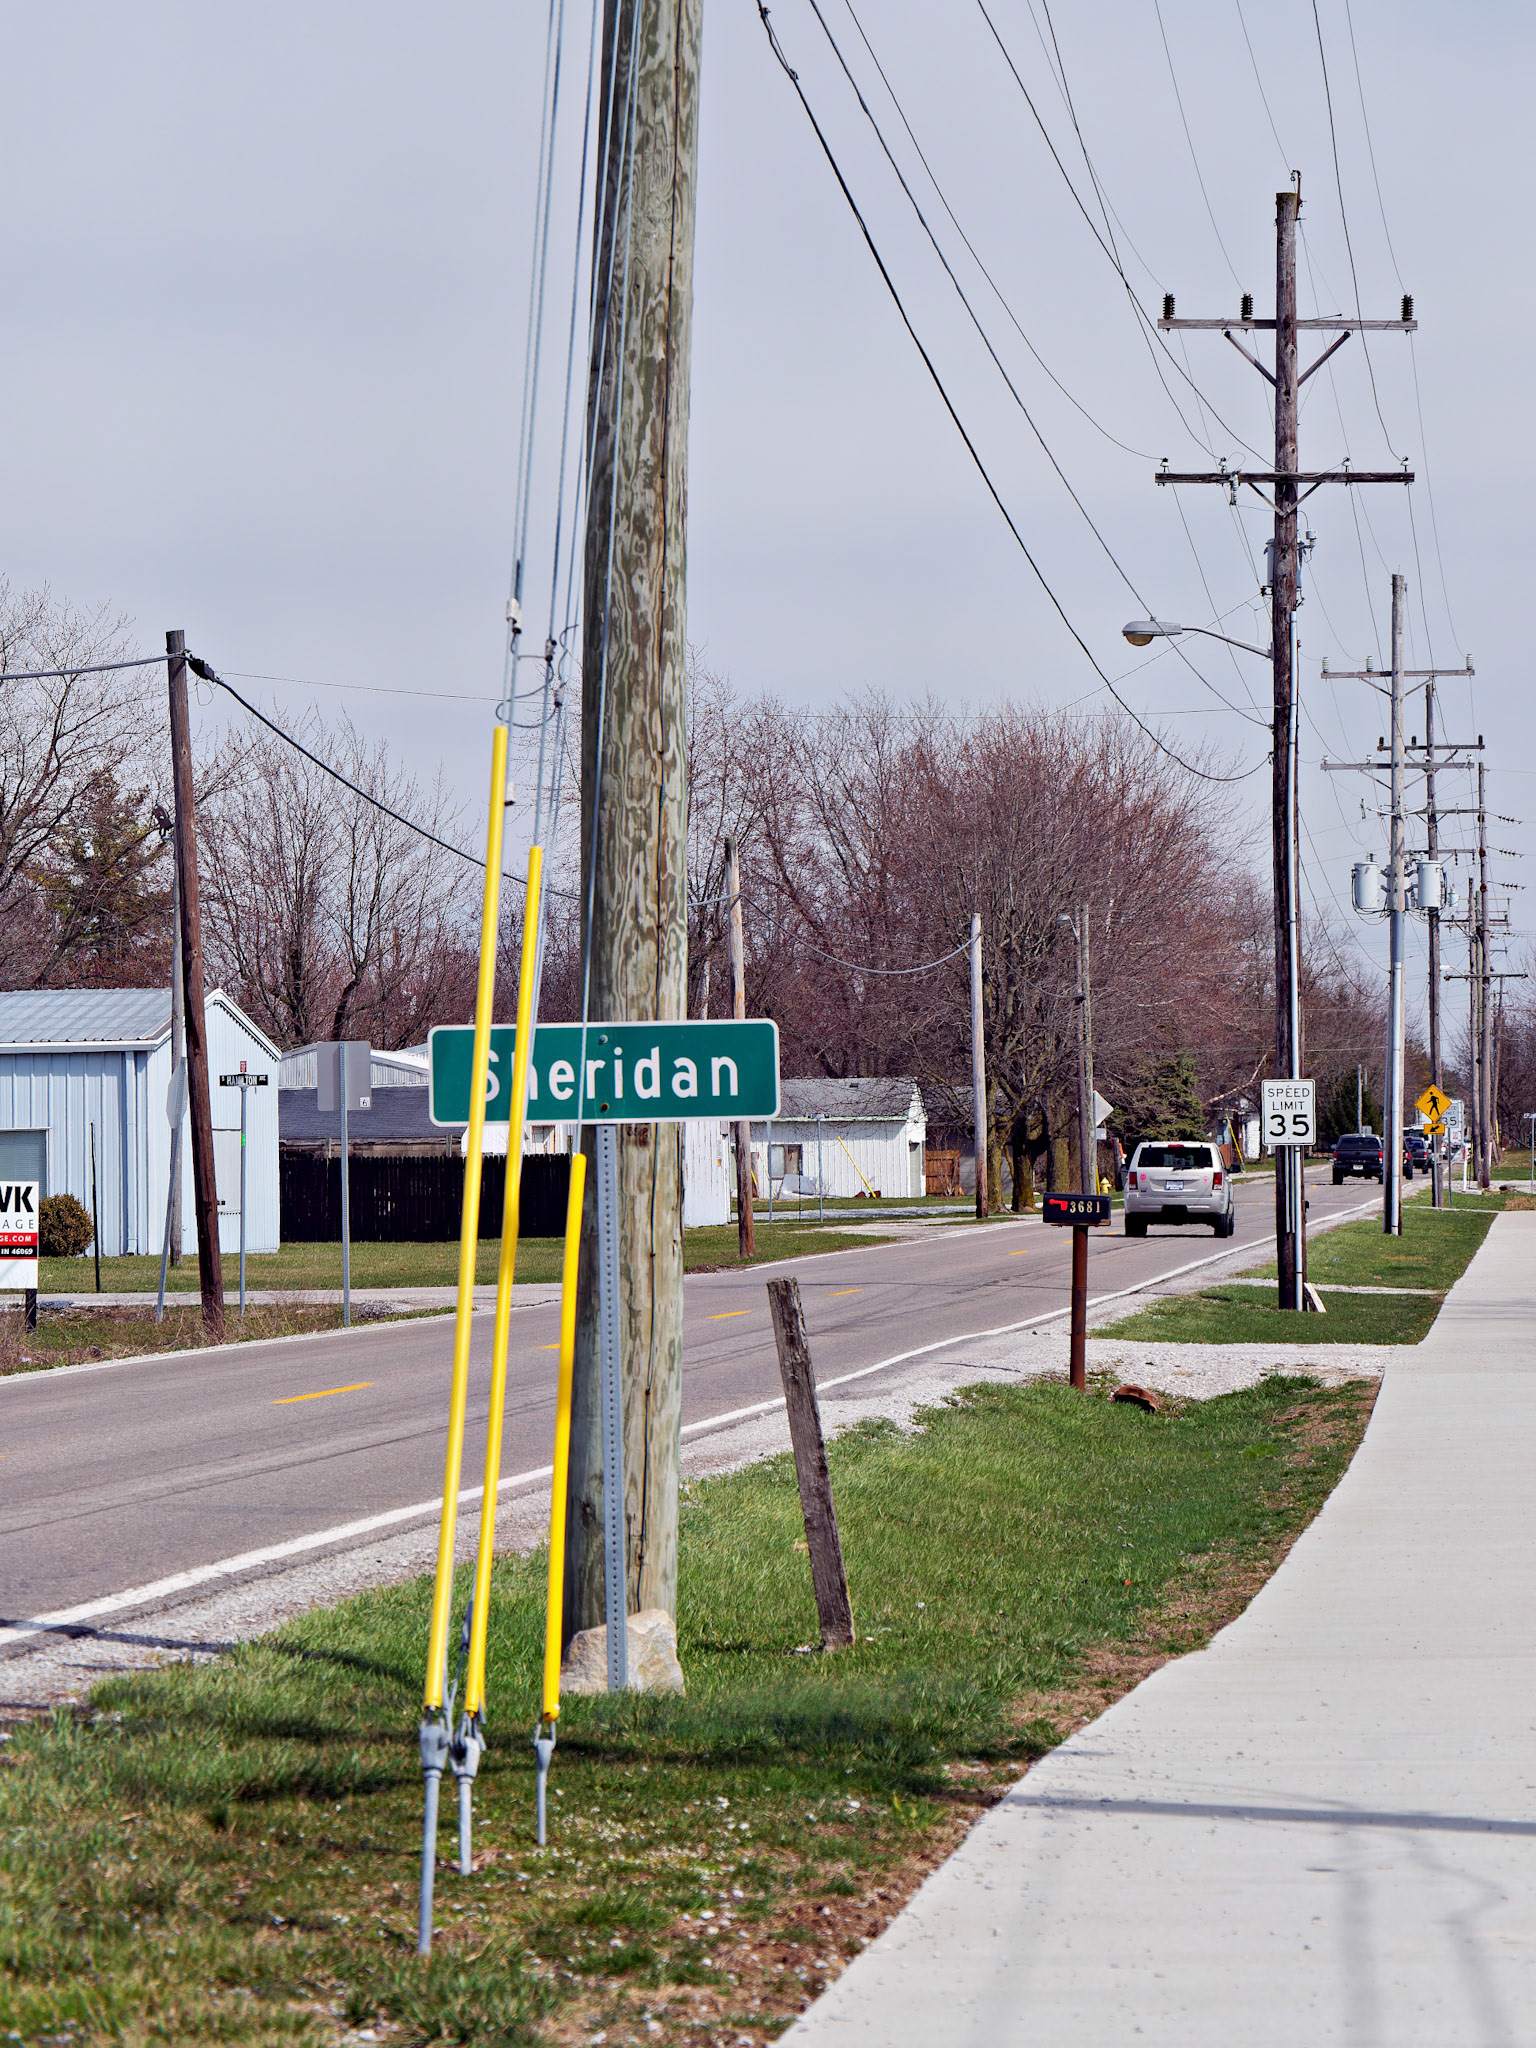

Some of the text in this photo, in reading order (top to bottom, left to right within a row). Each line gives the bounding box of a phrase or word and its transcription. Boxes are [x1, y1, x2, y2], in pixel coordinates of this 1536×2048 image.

[1267, 1087, 1310, 1098] SPEED
[1272, 1101, 1305, 1111] LIMIT
[1269, 1114, 1310, 1137] 35
[1442, 1117, 1457, 1126] 35
[1069, 1200, 1101, 1213] 3681
[2, 1219, 34, 1229] AGE
